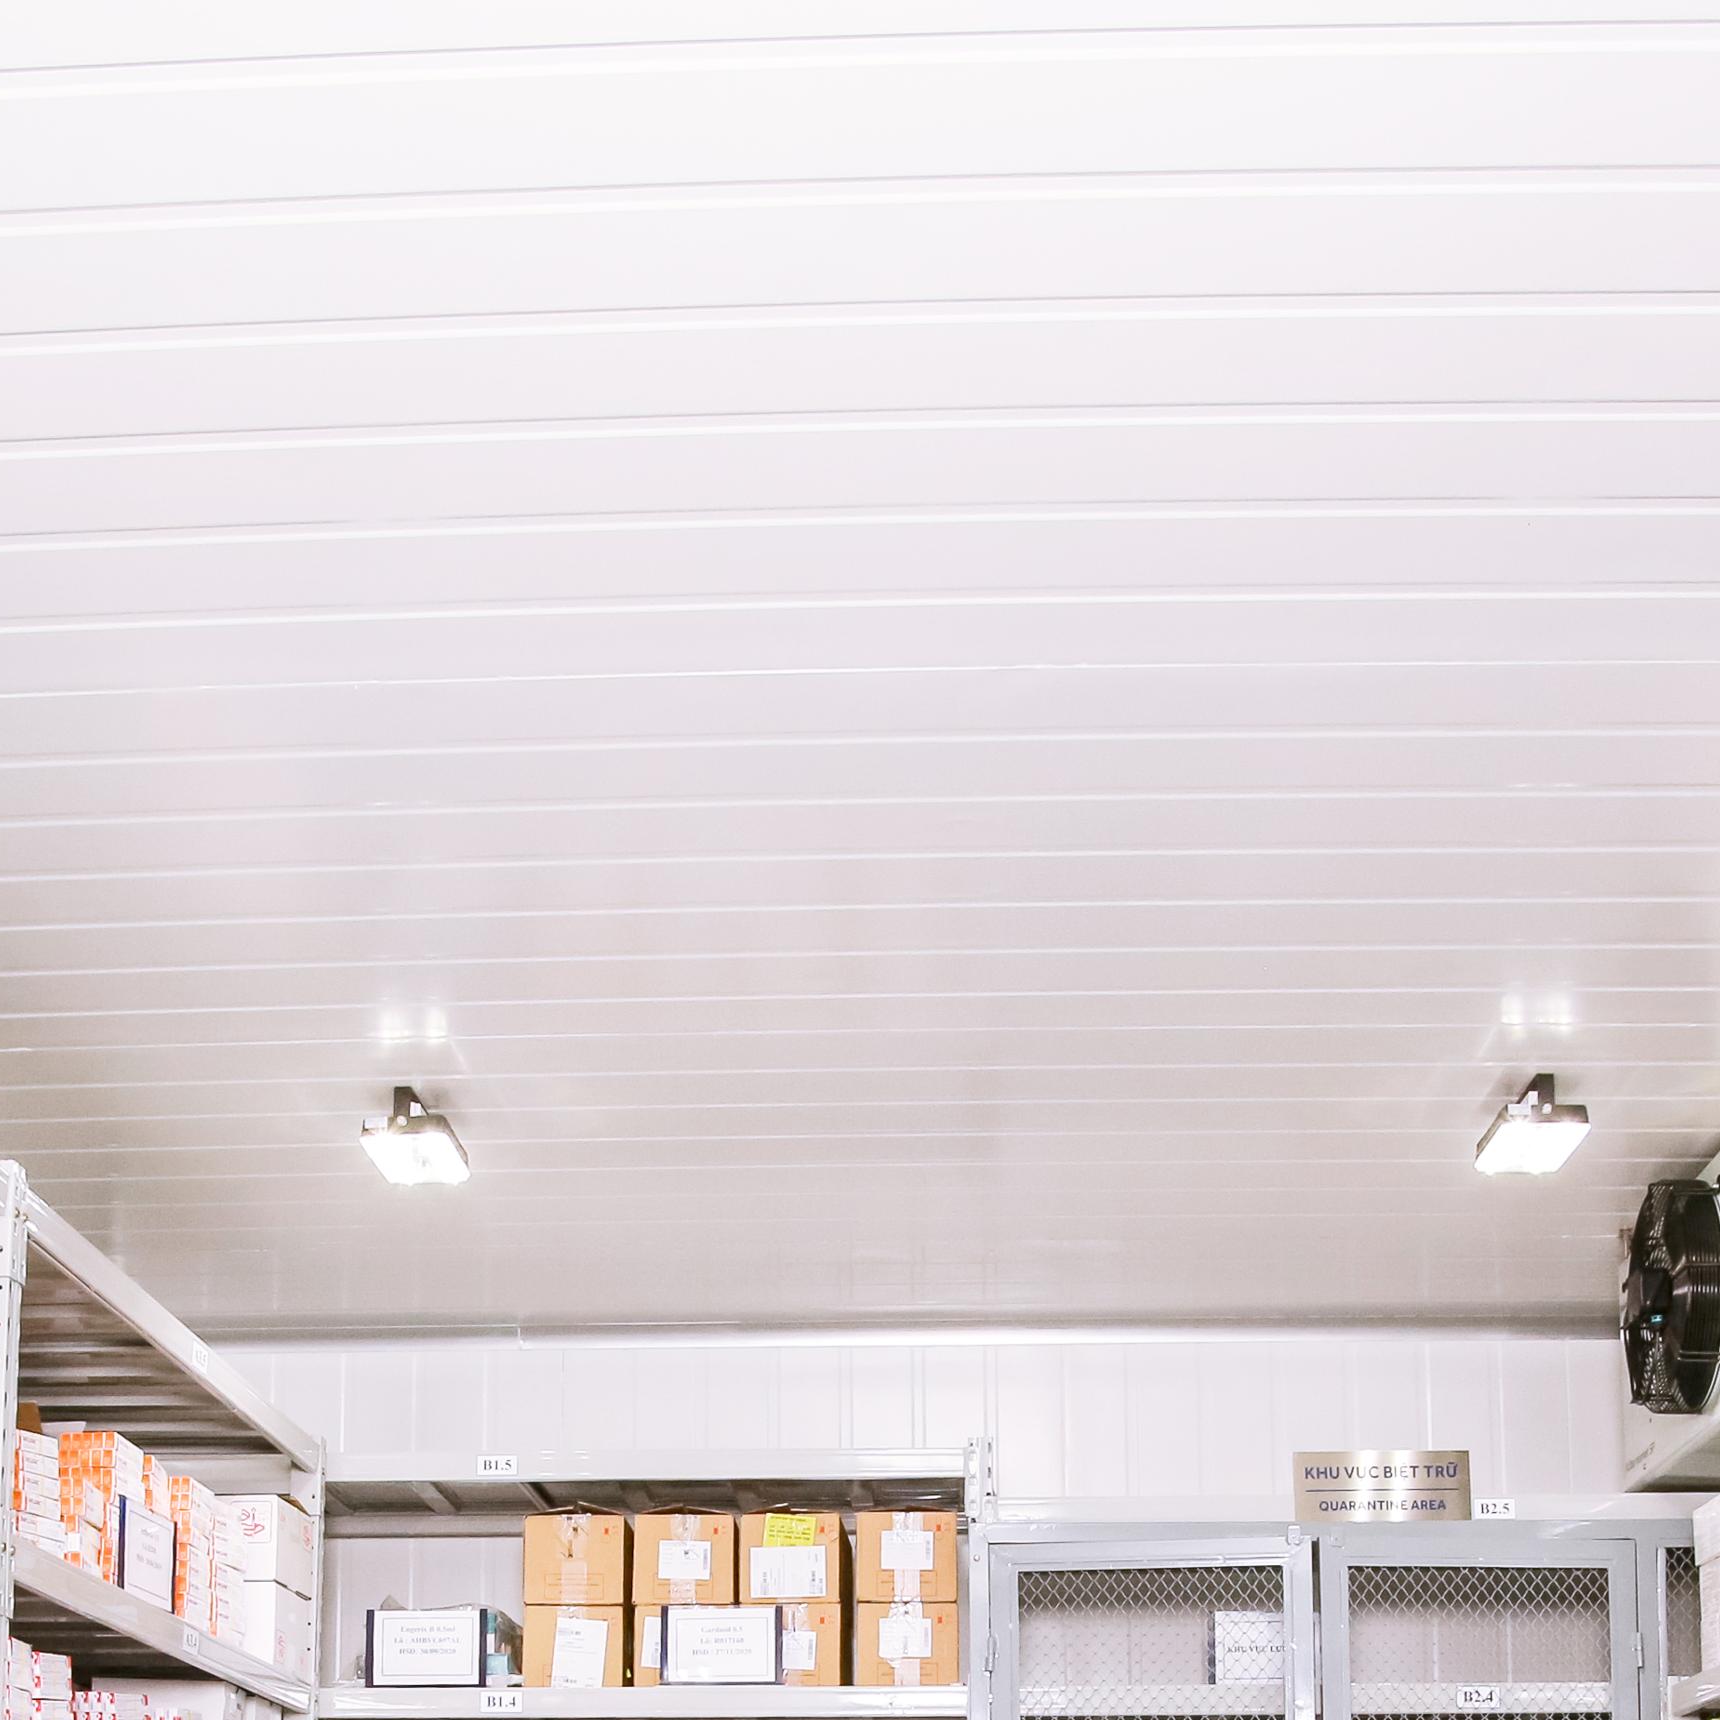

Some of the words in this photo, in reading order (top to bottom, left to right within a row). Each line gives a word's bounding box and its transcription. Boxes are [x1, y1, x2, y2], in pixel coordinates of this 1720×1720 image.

[483, 1459, 512, 1471] B1.5
[1304, 1465, 1340, 1480] KHU
[1318, 1500, 1408, 1512] QUARANTINE
[1411, 1499, 1447, 1511] AREA
[1480, 1503, 1510, 1515] B2.5
[487, 1696, 516, 1708] B1.4
[1463, 1690, 1494, 1703] B2.4
